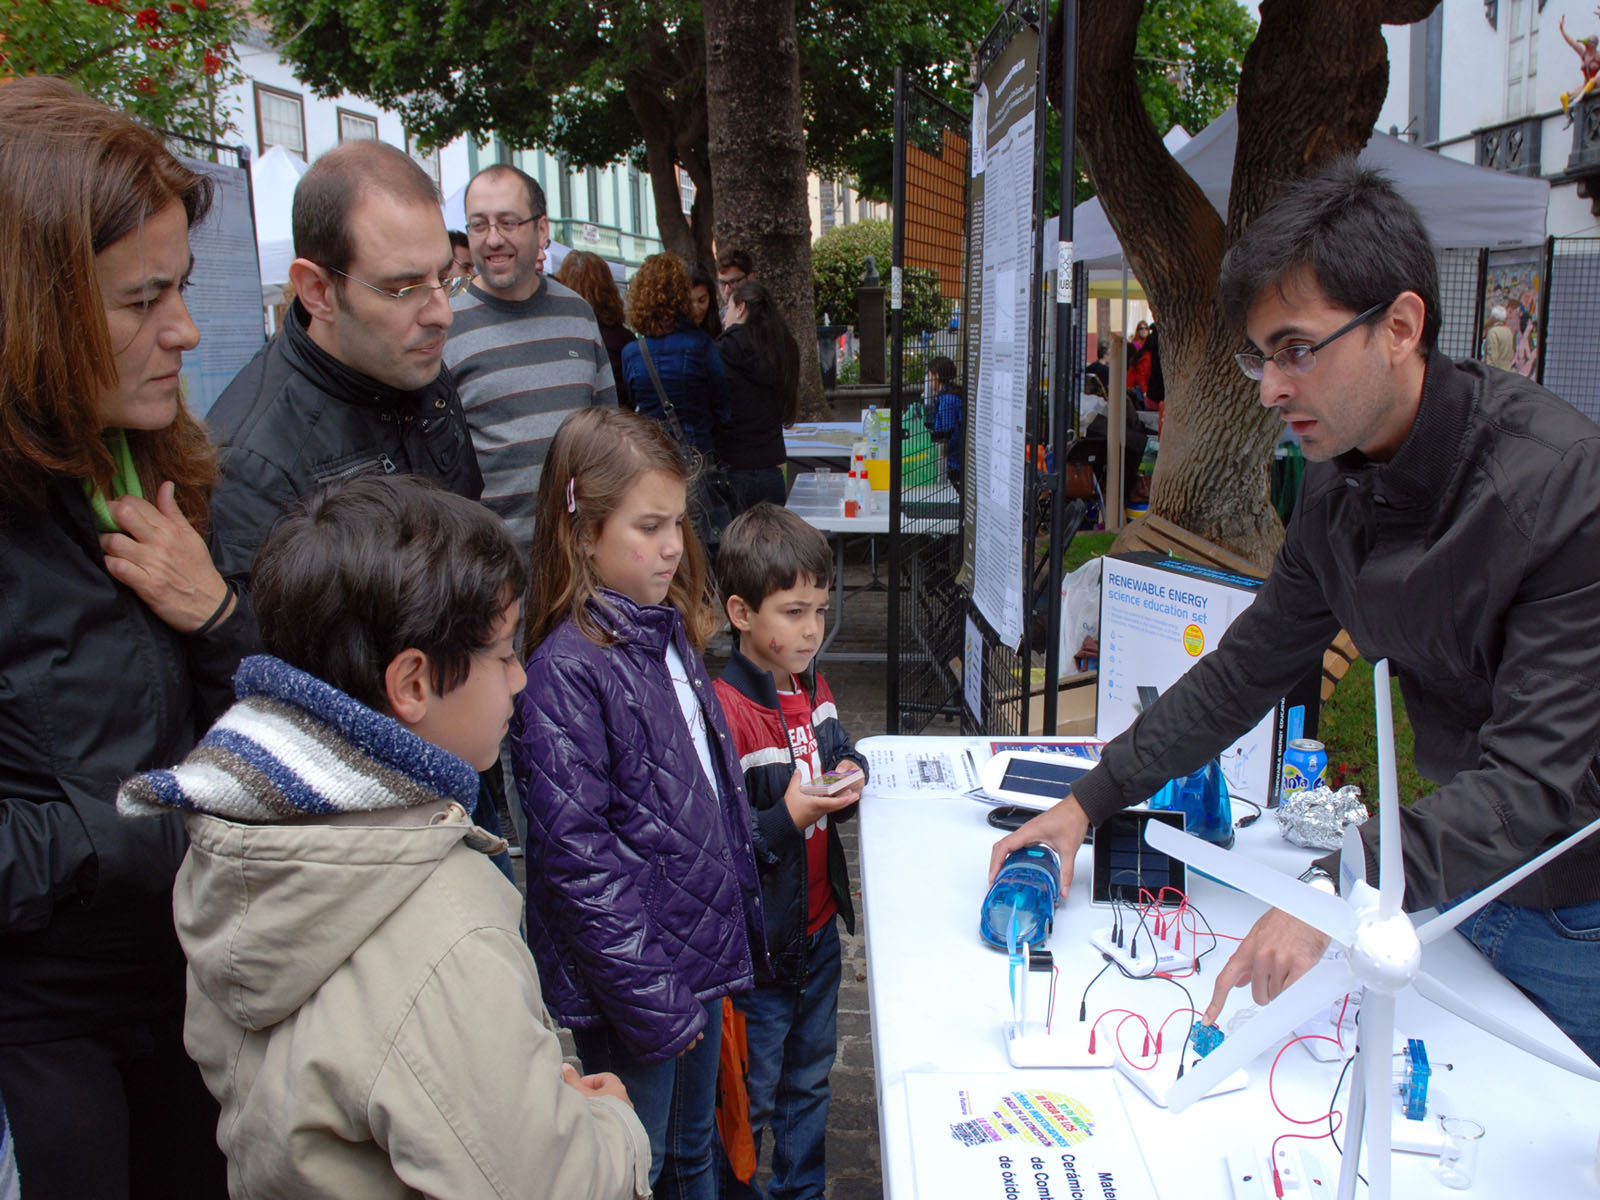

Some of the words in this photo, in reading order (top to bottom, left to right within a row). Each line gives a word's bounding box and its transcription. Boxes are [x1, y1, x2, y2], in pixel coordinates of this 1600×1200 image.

[1108, 573, 1166, 598] RENEWABLE
[1168, 588, 1208, 609] ENERGY
[1108, 589, 1141, 607] science
[1143, 598, 1189, 620] education
[1191, 611, 1208, 625] set
[998, 1155, 1014, 1169] de
[1030, 1156, 1046, 1171] de
[1061, 1154, 1085, 1200] Cerámic
